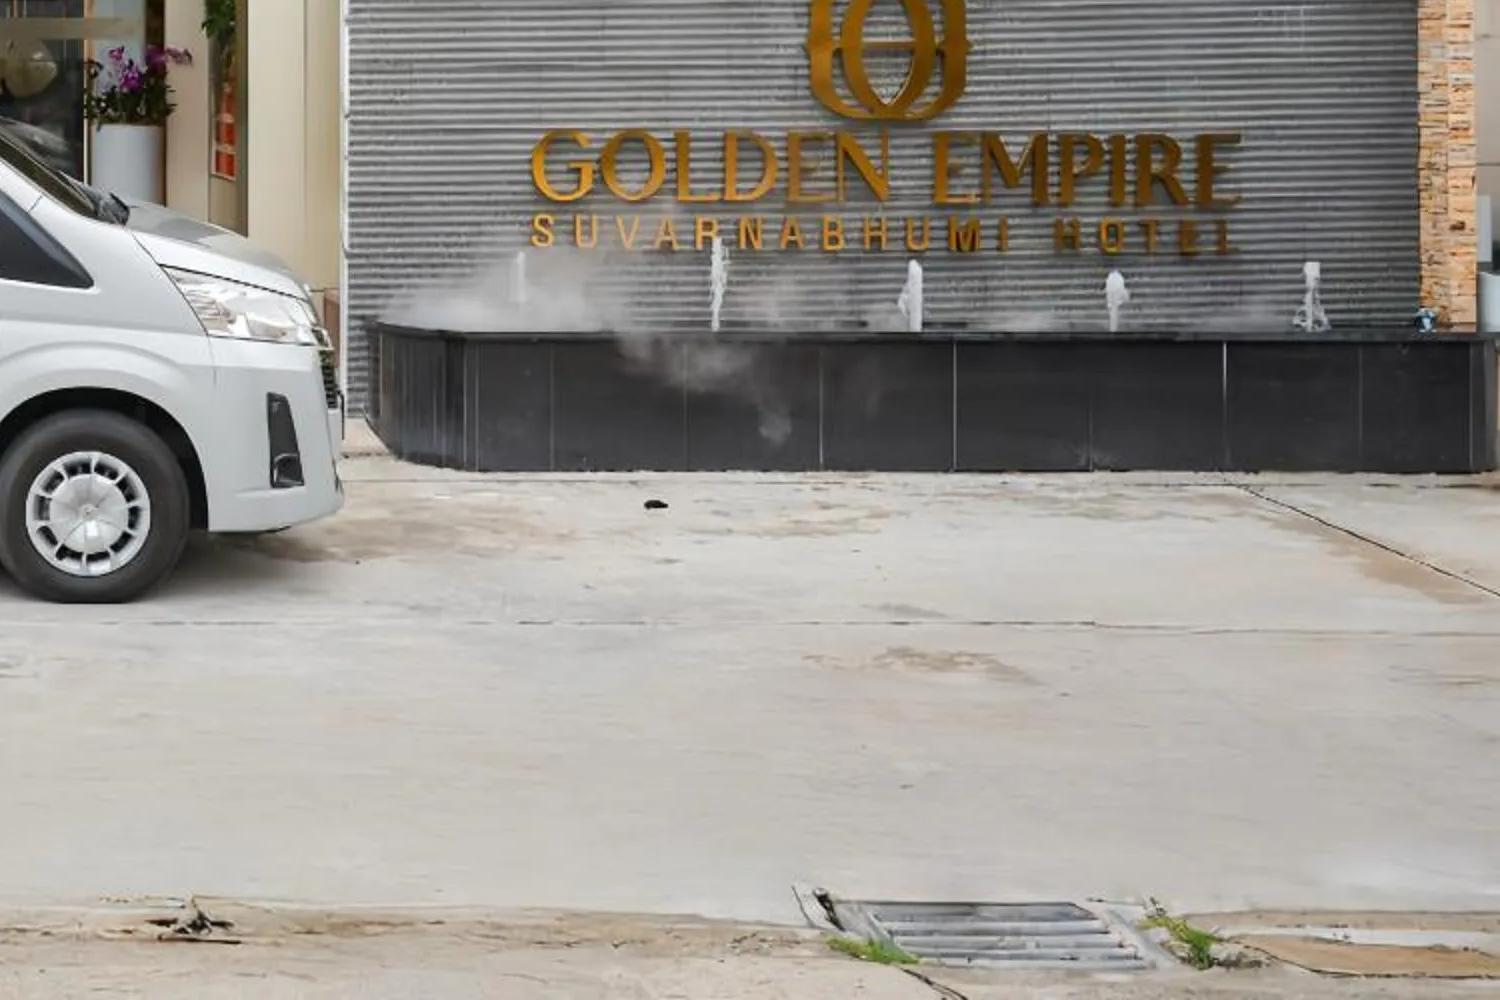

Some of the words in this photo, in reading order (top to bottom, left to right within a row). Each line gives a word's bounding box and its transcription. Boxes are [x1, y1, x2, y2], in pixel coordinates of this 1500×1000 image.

[530, 127, 891, 203] GOLDEN
[930, 129, 1243, 207] EMPIRE
[530, 213, 1009, 253] SUVARNABHUMI
[1053, 217, 1240, 256] HOTEL
